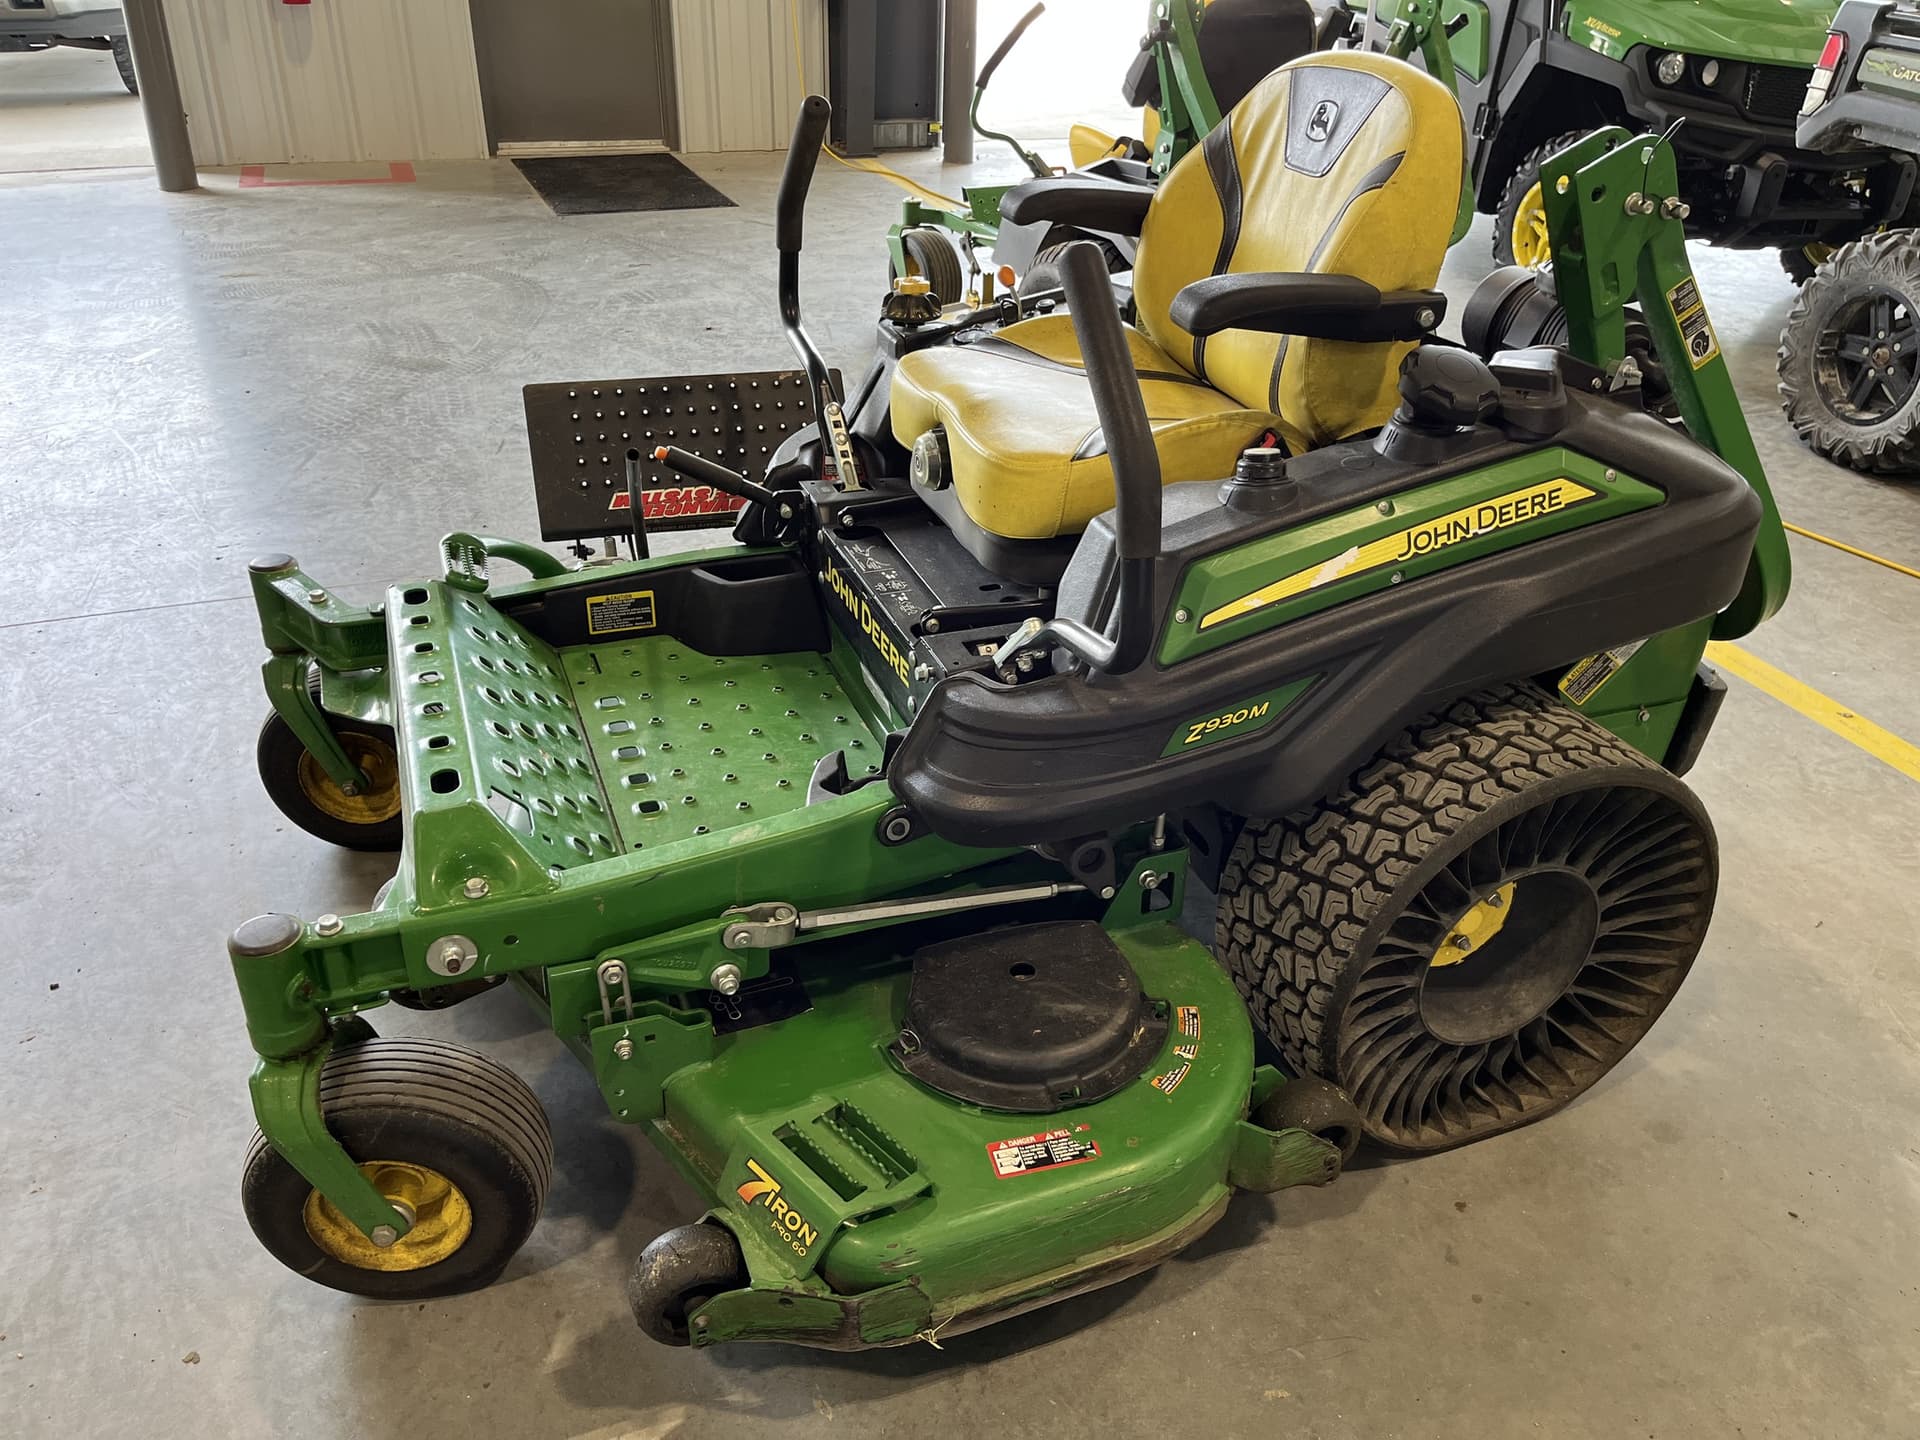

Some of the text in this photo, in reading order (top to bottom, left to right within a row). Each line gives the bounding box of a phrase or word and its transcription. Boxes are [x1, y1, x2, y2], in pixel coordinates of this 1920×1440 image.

[1397, 487, 1563, 559] JOHN DEERE
[825, 556, 910, 689] JOHN DEERE
[1184, 701, 1270, 744] Z930M
[1007, 1136, 1037, 1147] DANGER
[791, 1241, 807, 1257] 60
